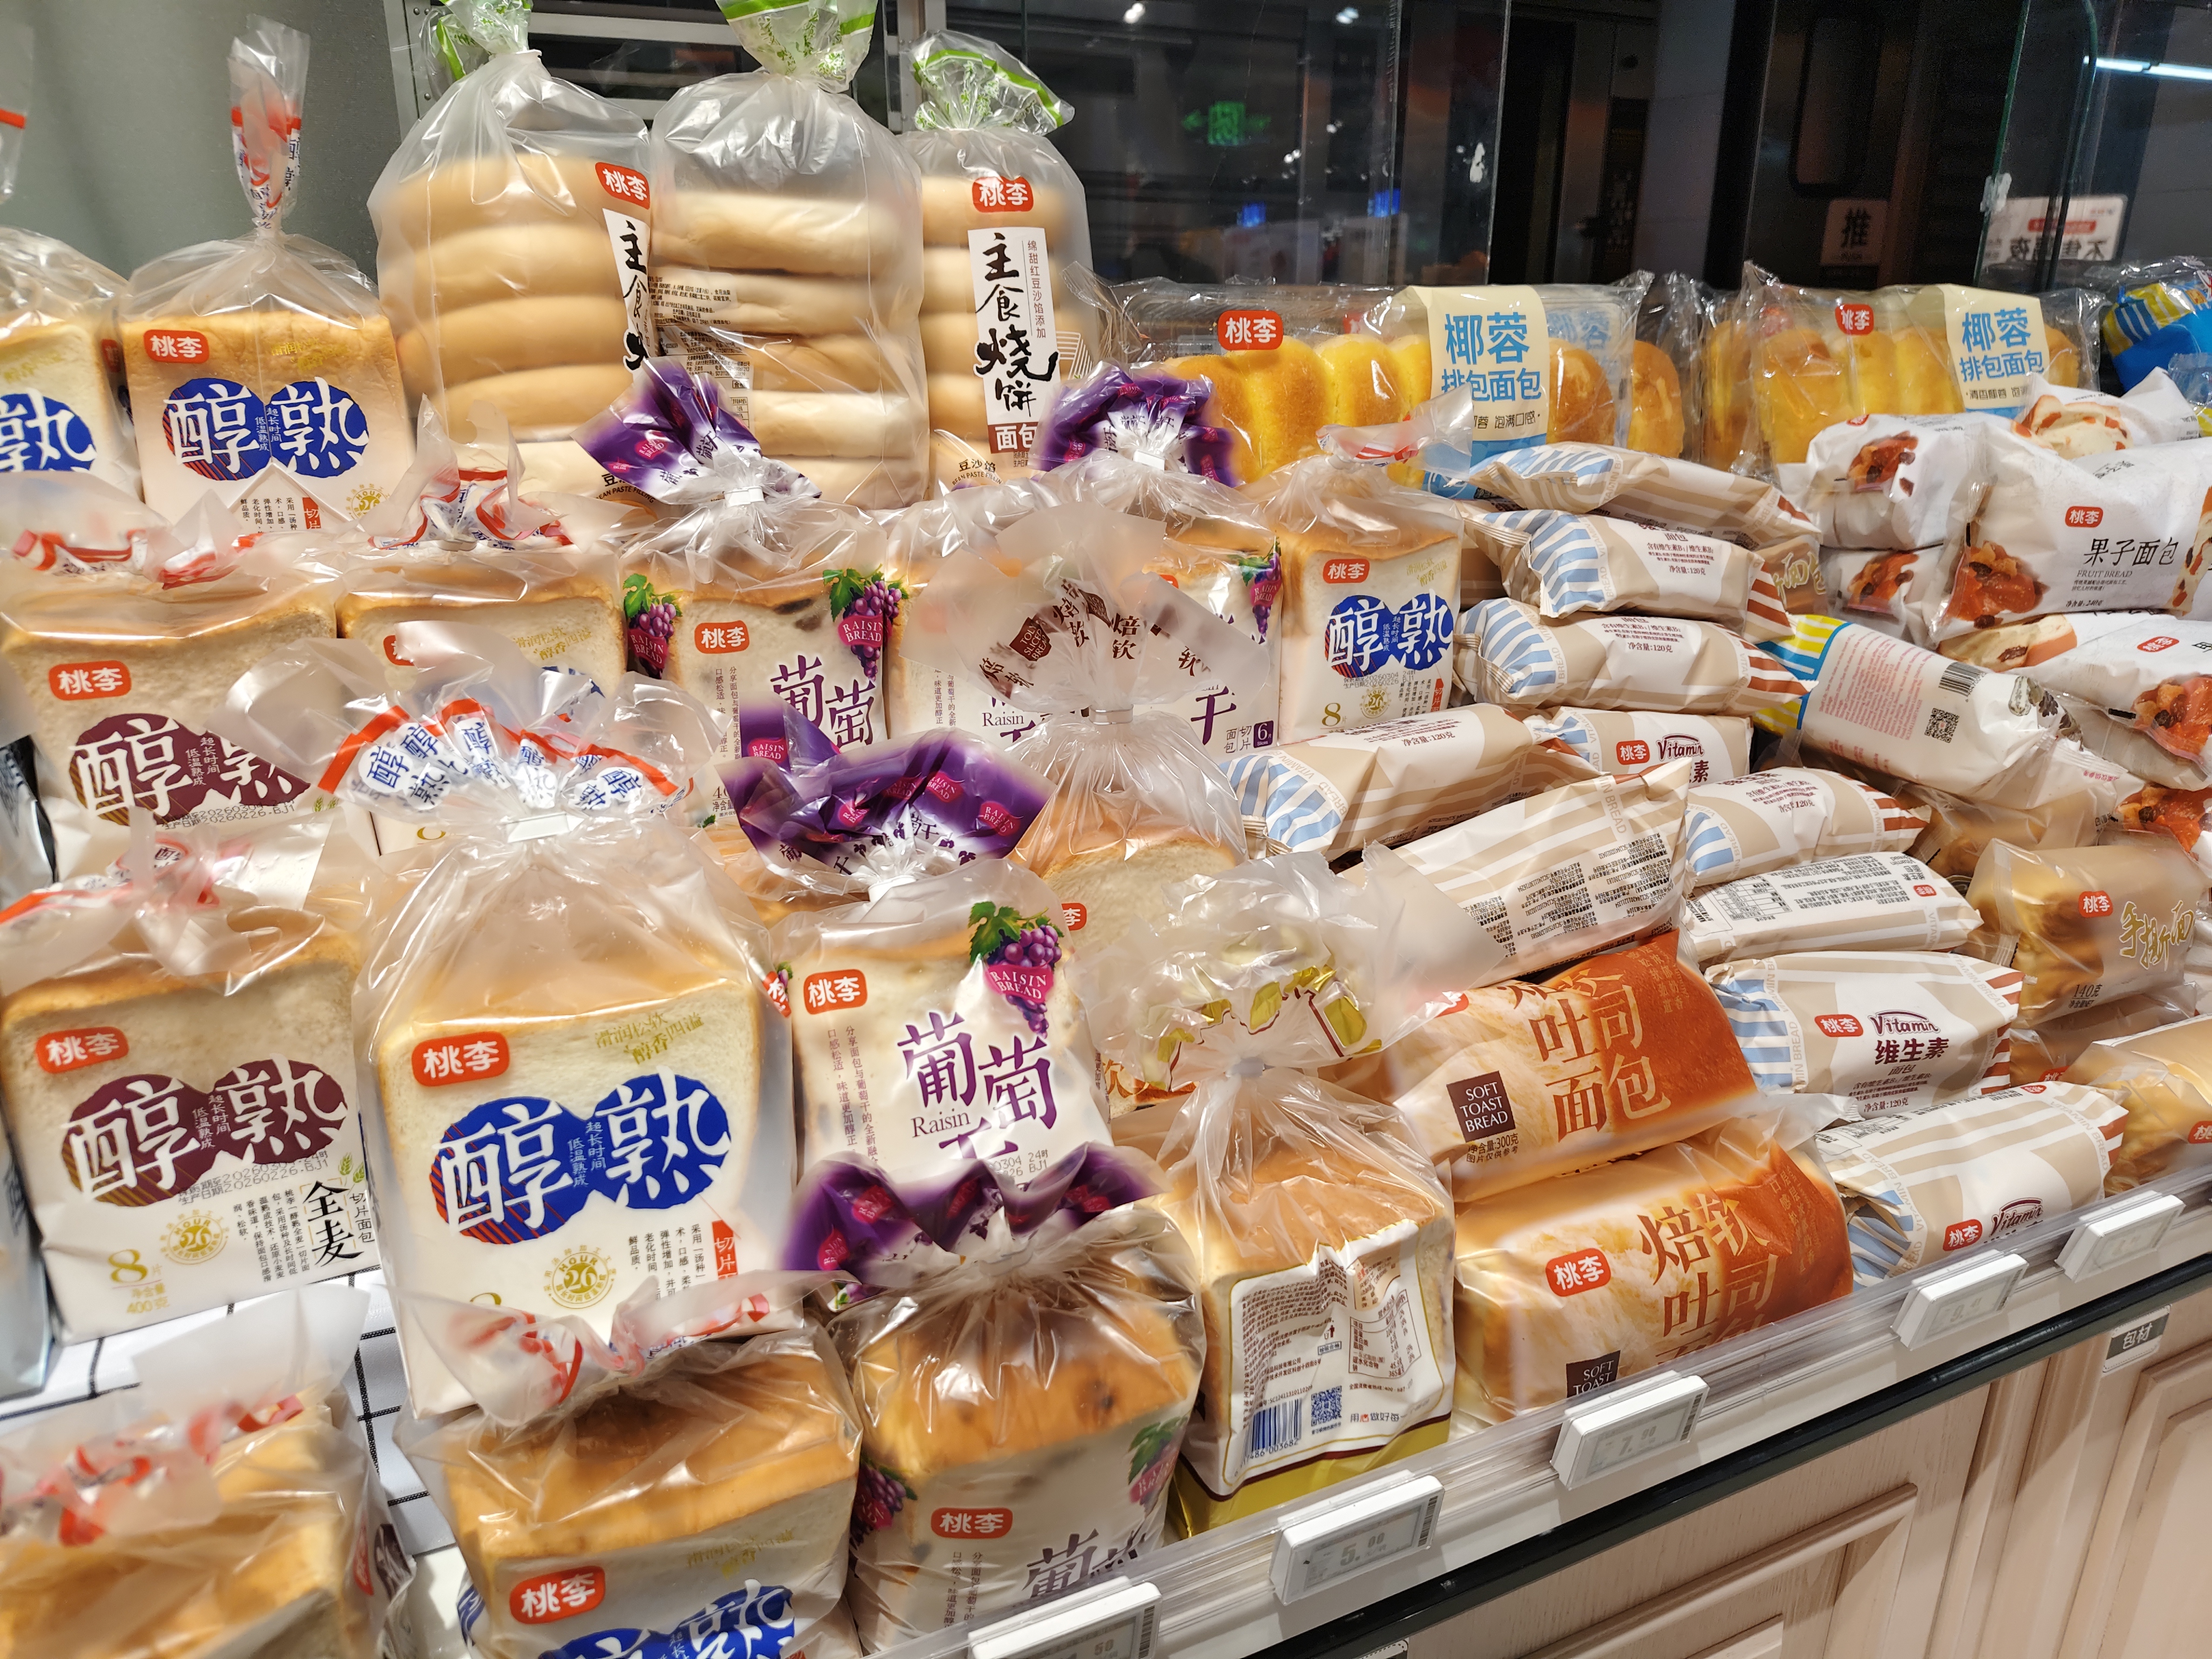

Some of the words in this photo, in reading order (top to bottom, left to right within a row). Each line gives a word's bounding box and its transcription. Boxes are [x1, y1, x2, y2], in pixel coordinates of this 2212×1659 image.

[603, 167, 648, 204] 桃李
[980, 179, 1029, 207] 桃李
[1840, 208, 1870, 248] 推
[1027, 240, 1047, 339] 绵甜红豆沙馅添加
[976, 232, 1058, 416] 主食烧饼
[1224, 318, 1278, 345] 桃李
[1840, 309, 1871, 331] 桃李
[1962, 308, 2032, 353] 椰蓉
[150, 336, 202, 359] 桃李
[1445, 312, 1529, 366] 椰蓉
[1959, 350, 2045, 382] 排包面包
[1441, 368, 1542, 404] 排包面包
[164, 377, 370, 474] 醇熟
[254, 416, 270, 452] 低温熟成
[267, 407, 282, 443] 超长时间
[995, 424, 1036, 451] 面包
[959, 459, 998, 473] 豆沙馅
[984, 472, 1003, 485] FILLIN
[612, 486, 632, 495] PASTE
[632, 485, 657, 504] FILLING
[2069, 509, 2100, 524] 桃李
[2083, 536, 2179, 567] 果子面包
[1327, 563, 1365, 581] 桃李
[2076, 570, 2104, 578] FRUIT
[2105, 570, 2133, 578] BREAD
[701, 626, 746, 650] 桃李
[842, 620, 884, 634] RAISIN
[845, 630, 882, 643] BREAD
[1020, 624, 1038, 646] TOLY
[1326, 588, 1454, 672] 醇熟
[1382, 623, 1392, 652] 低温熟成
[1392, 616, 1402, 644] 超长时间
[630, 634, 665, 655] RAISIN
[634, 644, 664, 665] BREAD
[1023, 628, 1044, 656] SLICED
[1030, 637, 1049, 662] BREAD
[58, 666, 123, 695] 桃李
[1368, 689, 1386, 699] HOUR
[770, 655, 875, 747] 葡萄
[1370, 696, 1384, 709] 26
[982, 711, 1025, 728] Raisin
[1191, 686, 1238, 746] 干
[752, 743, 785, 756] RAISIN
[1224, 729, 1237, 754] 面包
[1239, 726, 1251, 751] 切片
[1620, 744, 1647, 761] 桃李
[1656, 740, 1705, 761] Vitamin
[186, 749, 206, 786] 低温熟成
[200, 737, 221, 775] 超长时间
[753, 749, 783, 761] BREAD
[1318, 781, 1347, 816] BREAD
[1606, 793, 1628, 835] BREAD
[1062, 908, 1081, 927] 李
[2083, 895, 2110, 914] 桃李
[808, 975, 862, 1008] 桃李
[989, 970, 1048, 988] RAISIN
[997, 981, 1043, 999] BREAD
[2073, 984, 2103, 998] 140克
[1979, 980, 2007, 1009] BREAD
[595, 1010, 667, 1049] 滑润松软
[1529, 984, 1643, 1064] 吐司
[1821, 1017, 1859, 1034] 桃李
[1869, 1014, 1939, 1034] Vitamin
[48, 1031, 120, 1067] 桃李
[422, 1040, 500, 1078] 桃李
[1875, 1037, 1950, 1065] 维生素
[896, 1011, 1058, 1130] 葡萄
[1887, 1064, 1917, 1076] 面包
[1465, 1081, 1500, 1101] SOFT
[1546, 1052, 1673, 1143] 面包
[208, 1094, 232, 1135] 超长时间
[1459, 1096, 1503, 1118] TOAST
[60, 1053, 349, 1202] 醇熟
[193, 1108, 217, 1150] 低温熟成
[911, 1108, 971, 1138] Raisin
[1465, 1111, 1509, 1134] BREAD
[2050, 1100, 2094, 1132] VITAMIN
[2092, 1131, 2109, 1171] BREAD
[431, 1064, 732, 1235] 醇熟
[586, 1121, 606, 1171] 超长时间
[1028, 1148, 1049, 1163] 24时
[1465, 1145, 1519, 1165] 图片仅供参考
[568, 1138, 590, 1188] 低温熟成
[1028, 1161, 1049, 1175] BJ1
[174, 1217, 211, 1235] HOUR
[302, 1180, 365, 1268] 全麦
[349, 1192, 375, 1243] 切片面包
[1989, 1203, 2044, 1238] Vitamin
[180, 1224, 213, 1252] 26
[1639, 1192, 1771, 1274] 焙软
[1948, 1225, 1980, 1248] 桃李
[559, 1255, 599, 1274] HOUR
[564, 1266, 597, 1289] 26
[1554, 1257, 1606, 1292] 桃李
[1663, 1254, 1776, 1337] 吐司
[2121, 1323, 2154, 1351] 包材
[1582, 1359, 1615, 1380] SOFT
[939, 1513, 1004, 1535] 桃李
[522, 1572, 596, 1619] 桃李
